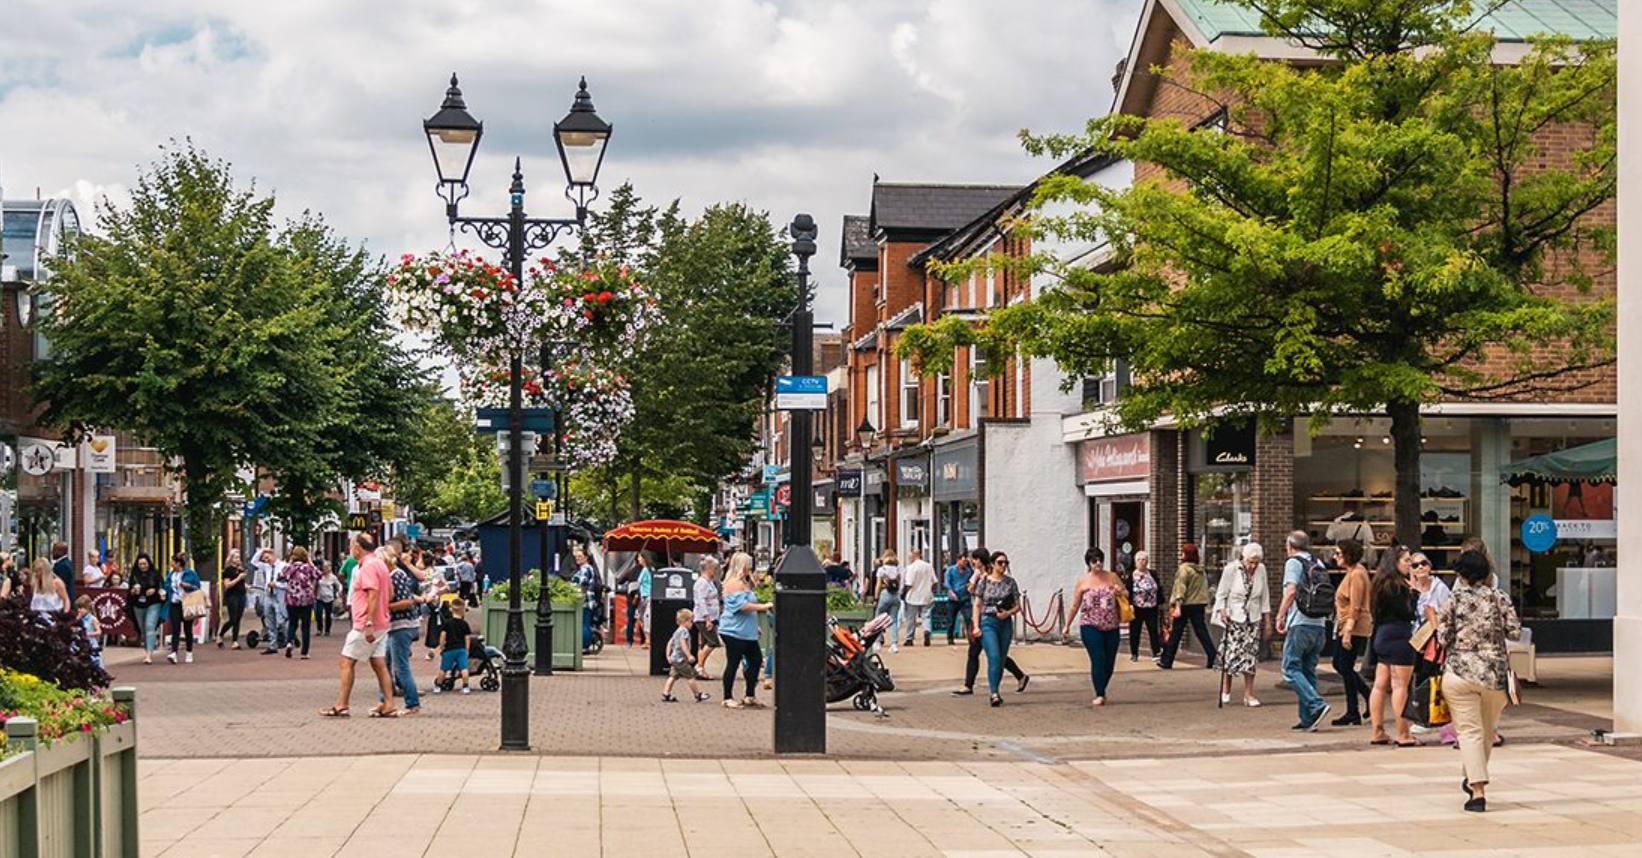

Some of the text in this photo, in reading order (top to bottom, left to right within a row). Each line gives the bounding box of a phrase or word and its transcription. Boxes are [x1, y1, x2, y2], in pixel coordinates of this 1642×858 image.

[1215, 451, 1247, 462] Clarks
[538, 503, 550, 517] H
[1528, 521, 1550, 534] 20%
